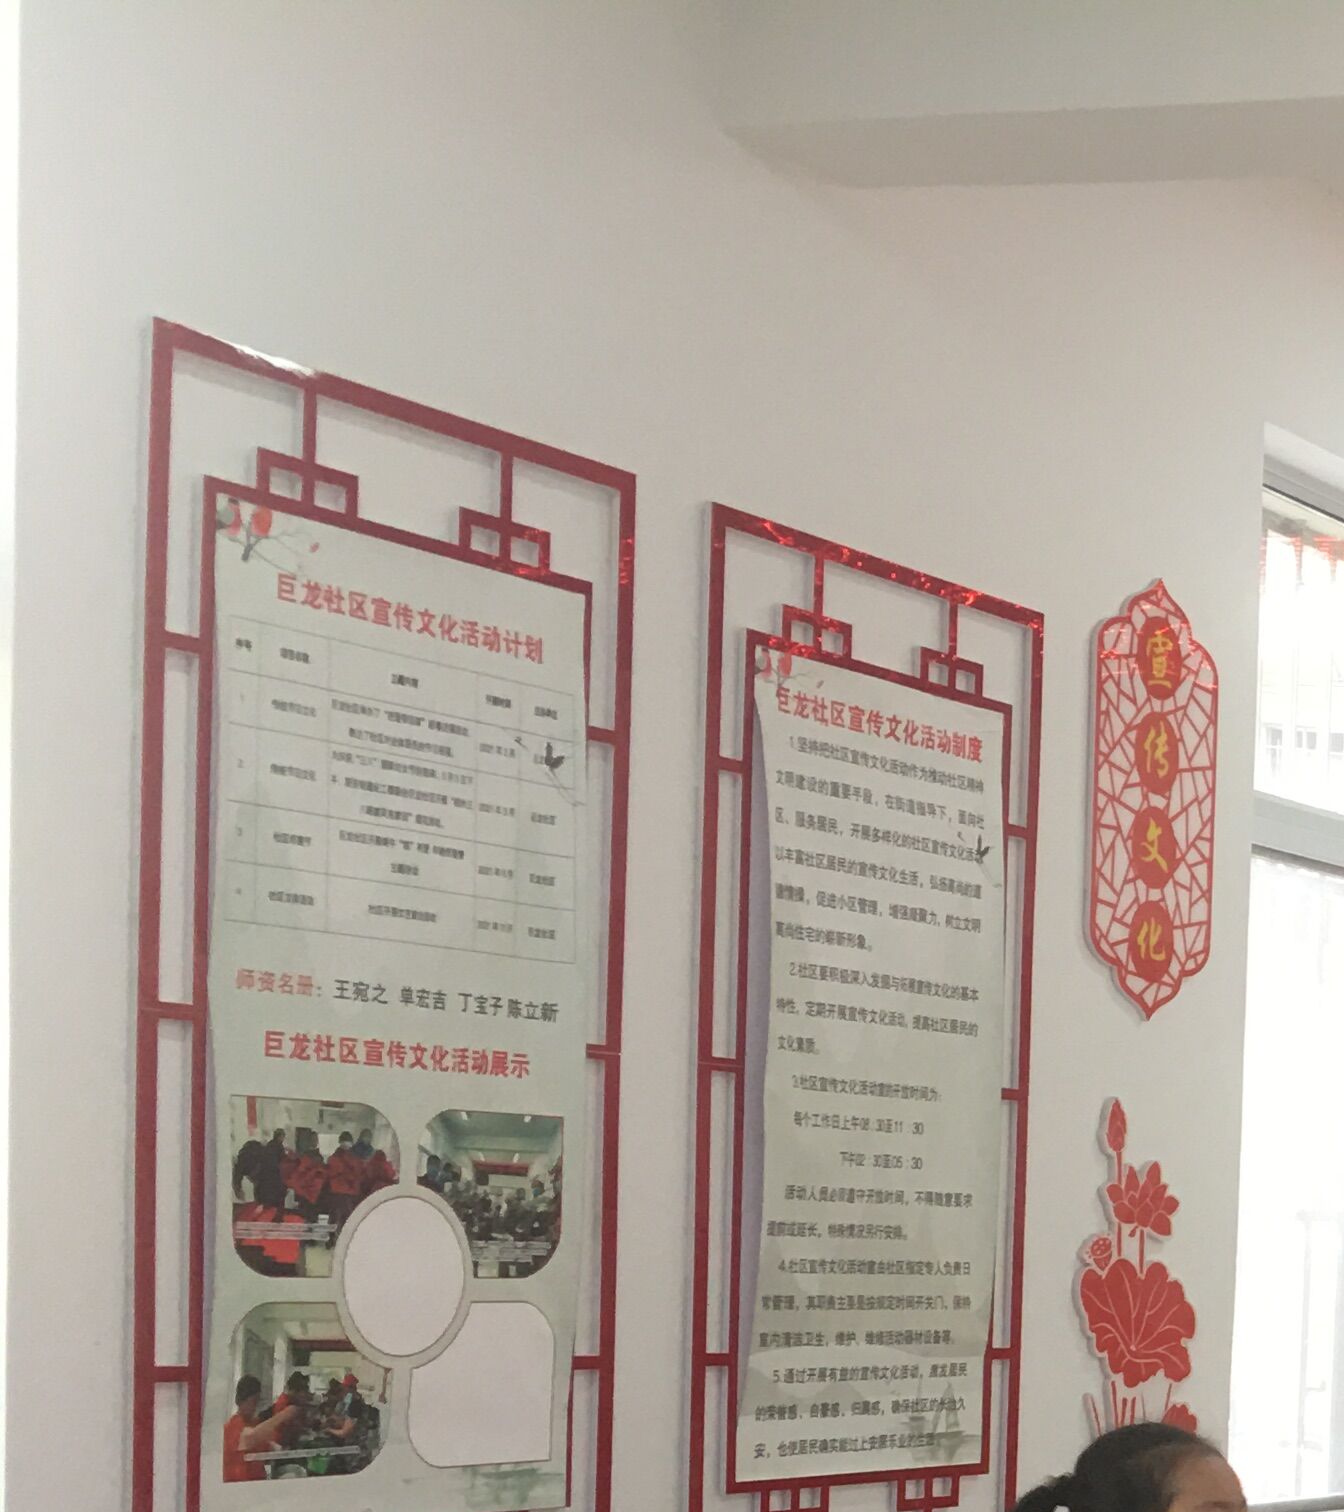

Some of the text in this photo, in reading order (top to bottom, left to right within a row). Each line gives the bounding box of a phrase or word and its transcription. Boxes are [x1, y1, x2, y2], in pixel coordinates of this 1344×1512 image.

[277, 572, 544, 664] 巨龙社区宣传文化活动计划
[776, 687, 983, 764] 巨龙社区宣传文化活动制度
[264, 1030, 531, 1079] 巨龙社区宣传文化活动展示
